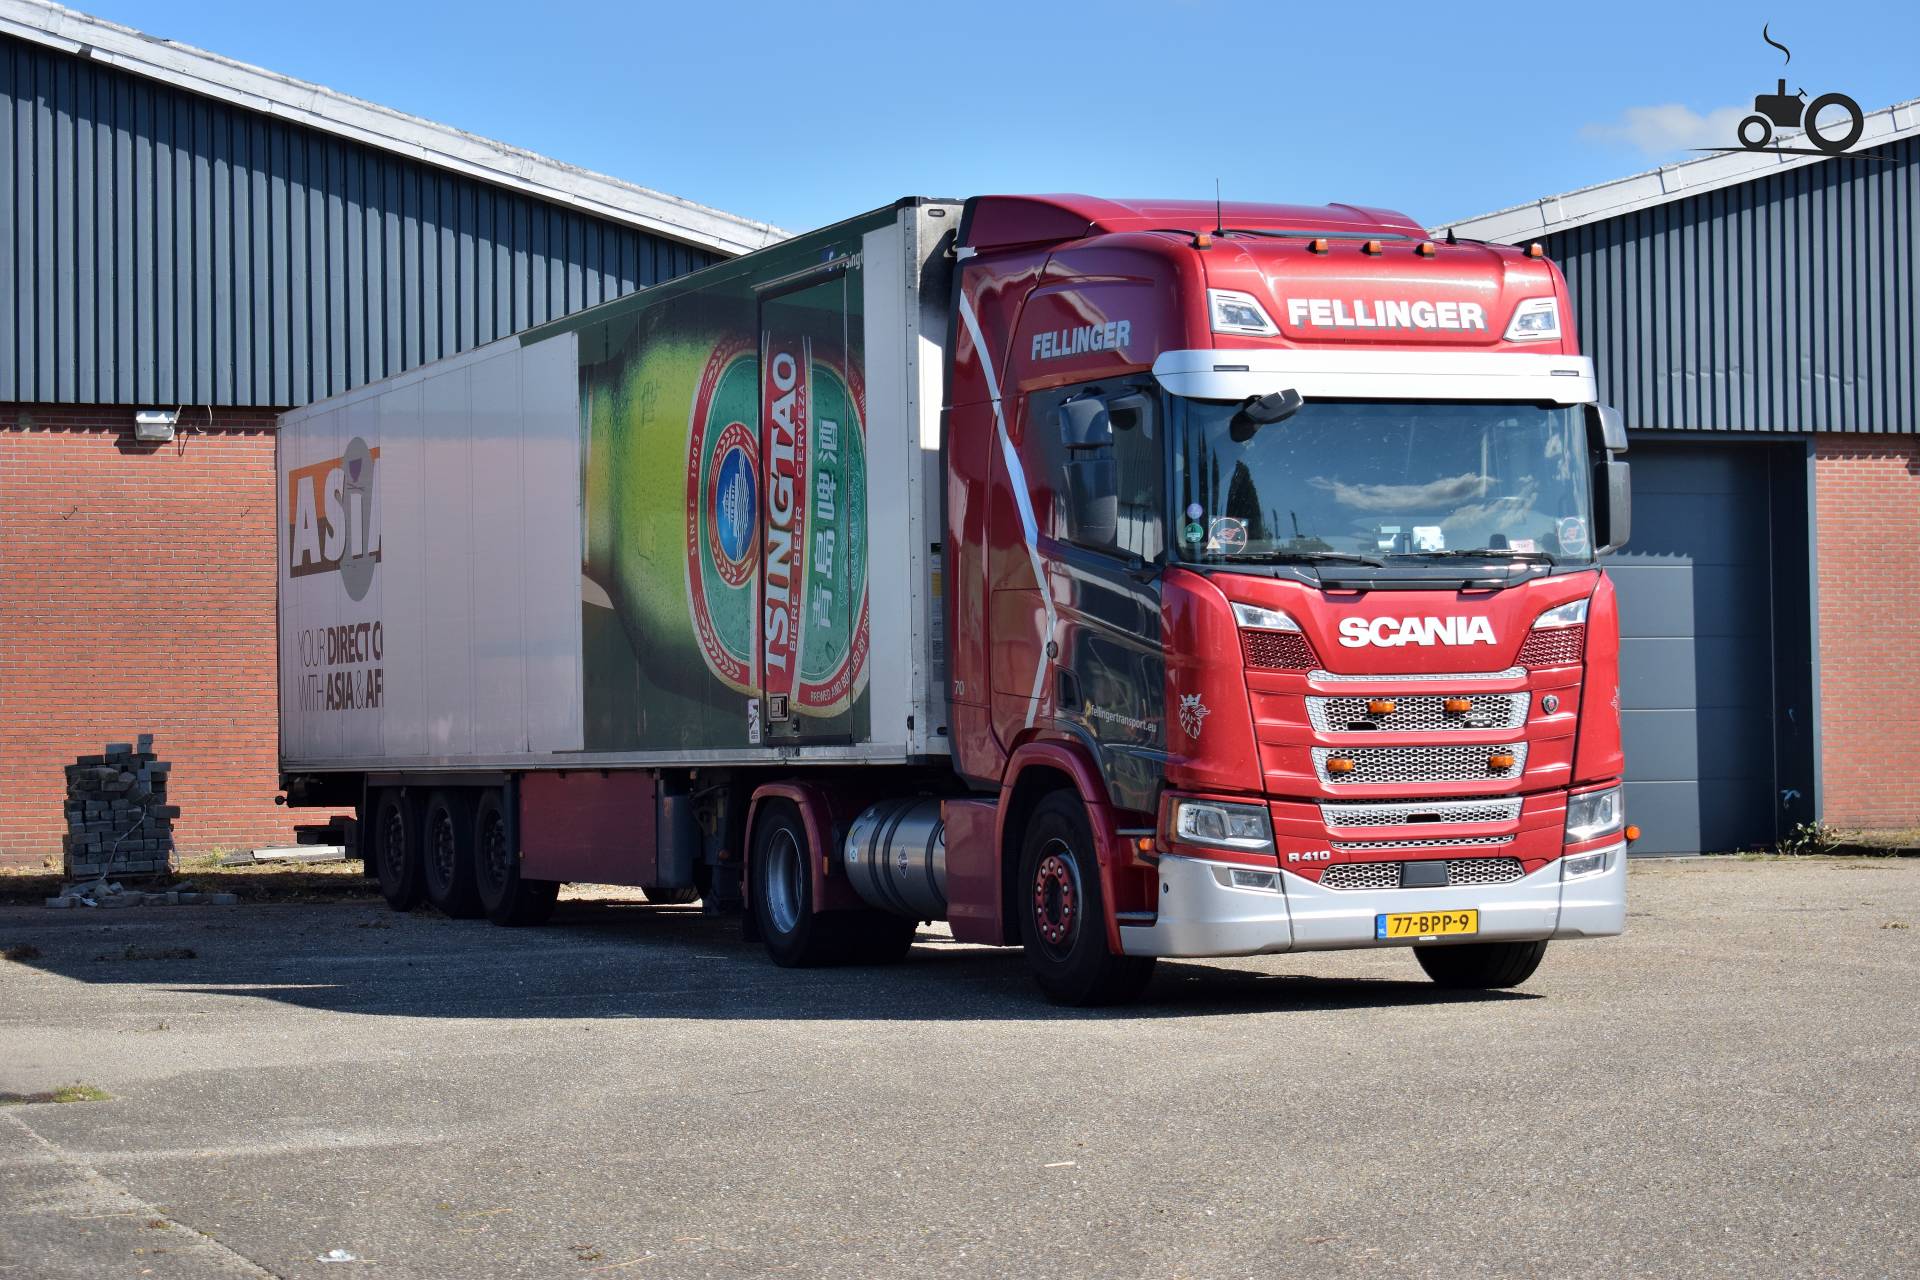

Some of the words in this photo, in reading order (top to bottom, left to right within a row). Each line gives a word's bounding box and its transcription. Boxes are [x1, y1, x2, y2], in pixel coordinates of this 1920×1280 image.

[1287, 298, 1486, 331] FELLINGER
[1032, 320, 1131, 361] FELLINGER
[797, 384, 806, 478] CERVEZA
[690, 434, 700, 478] 1903
[765, 353, 797, 676] TSINGTAO
[793, 506, 802, 566] BEER
[812, 417, 838, 631] 青島啤酒
[789, 593, 799, 651] BIERE
[1337, 615, 1497, 647] SCANIA
[297, 628, 326, 667] YOUR
[327, 622, 371, 665] DIRECT
[831, 681, 842, 696] AND
[857, 634, 866, 653] BY
[297, 672, 324, 712] WITH
[326, 671, 355, 711] ASIA
[355, 670, 364, 709] &
[365, 667, 384, 709] AF
[954, 680, 966, 696] 70
[1091, 704, 1157, 733] fellingertransport.eu
[1288, 852, 1300, 863] R
[1301, 850, 1331, 862] 410
[1393, 914, 1469, 934] 77-BPP-9
